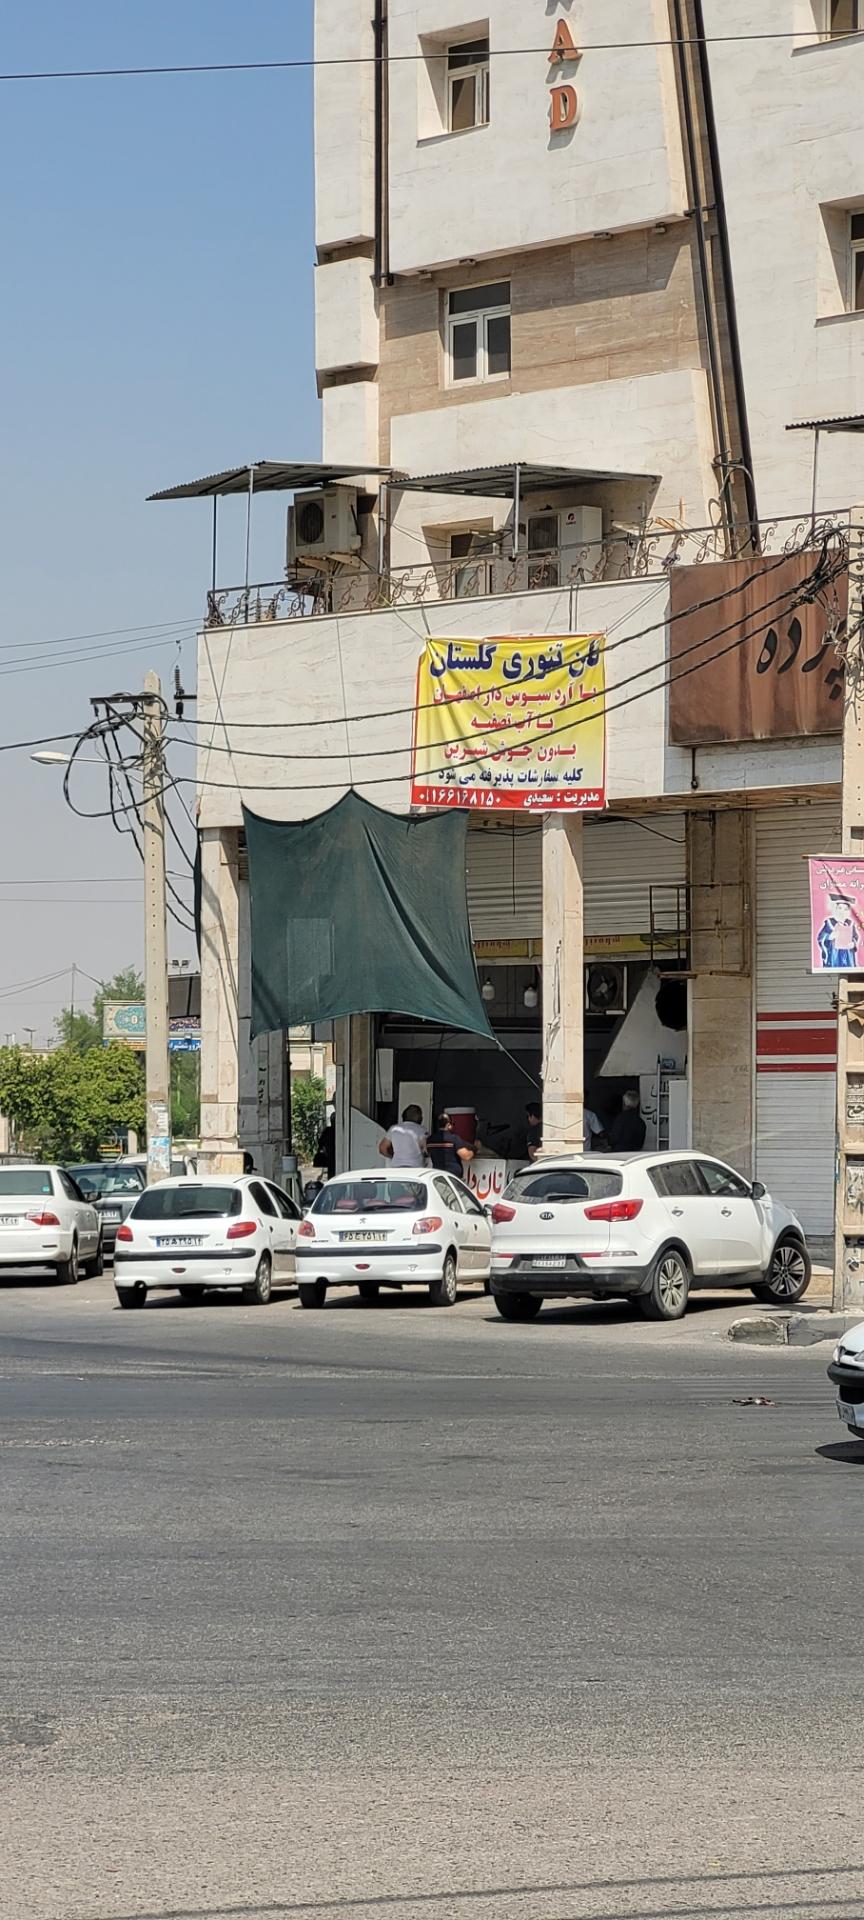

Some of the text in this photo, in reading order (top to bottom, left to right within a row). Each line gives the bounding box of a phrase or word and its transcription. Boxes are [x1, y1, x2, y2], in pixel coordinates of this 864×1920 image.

[430, 641, 497, 678] گلستان
[503, 642, 563, 680] تنوری
[433, 682, 597, 707] با آرد سبوس دار اصفهان
[470, 710, 554, 733] با آب تصفیه
[444, 740, 577, 762] بدون جوش شیرین
[438, 767, 583, 788] کلیه سفارشات پذیرفته می شود
[523, 792, 554, 807] سعیدی
[563, 790, 600, 806] مدیریت
[477, 1165, 502, 1200] نان
